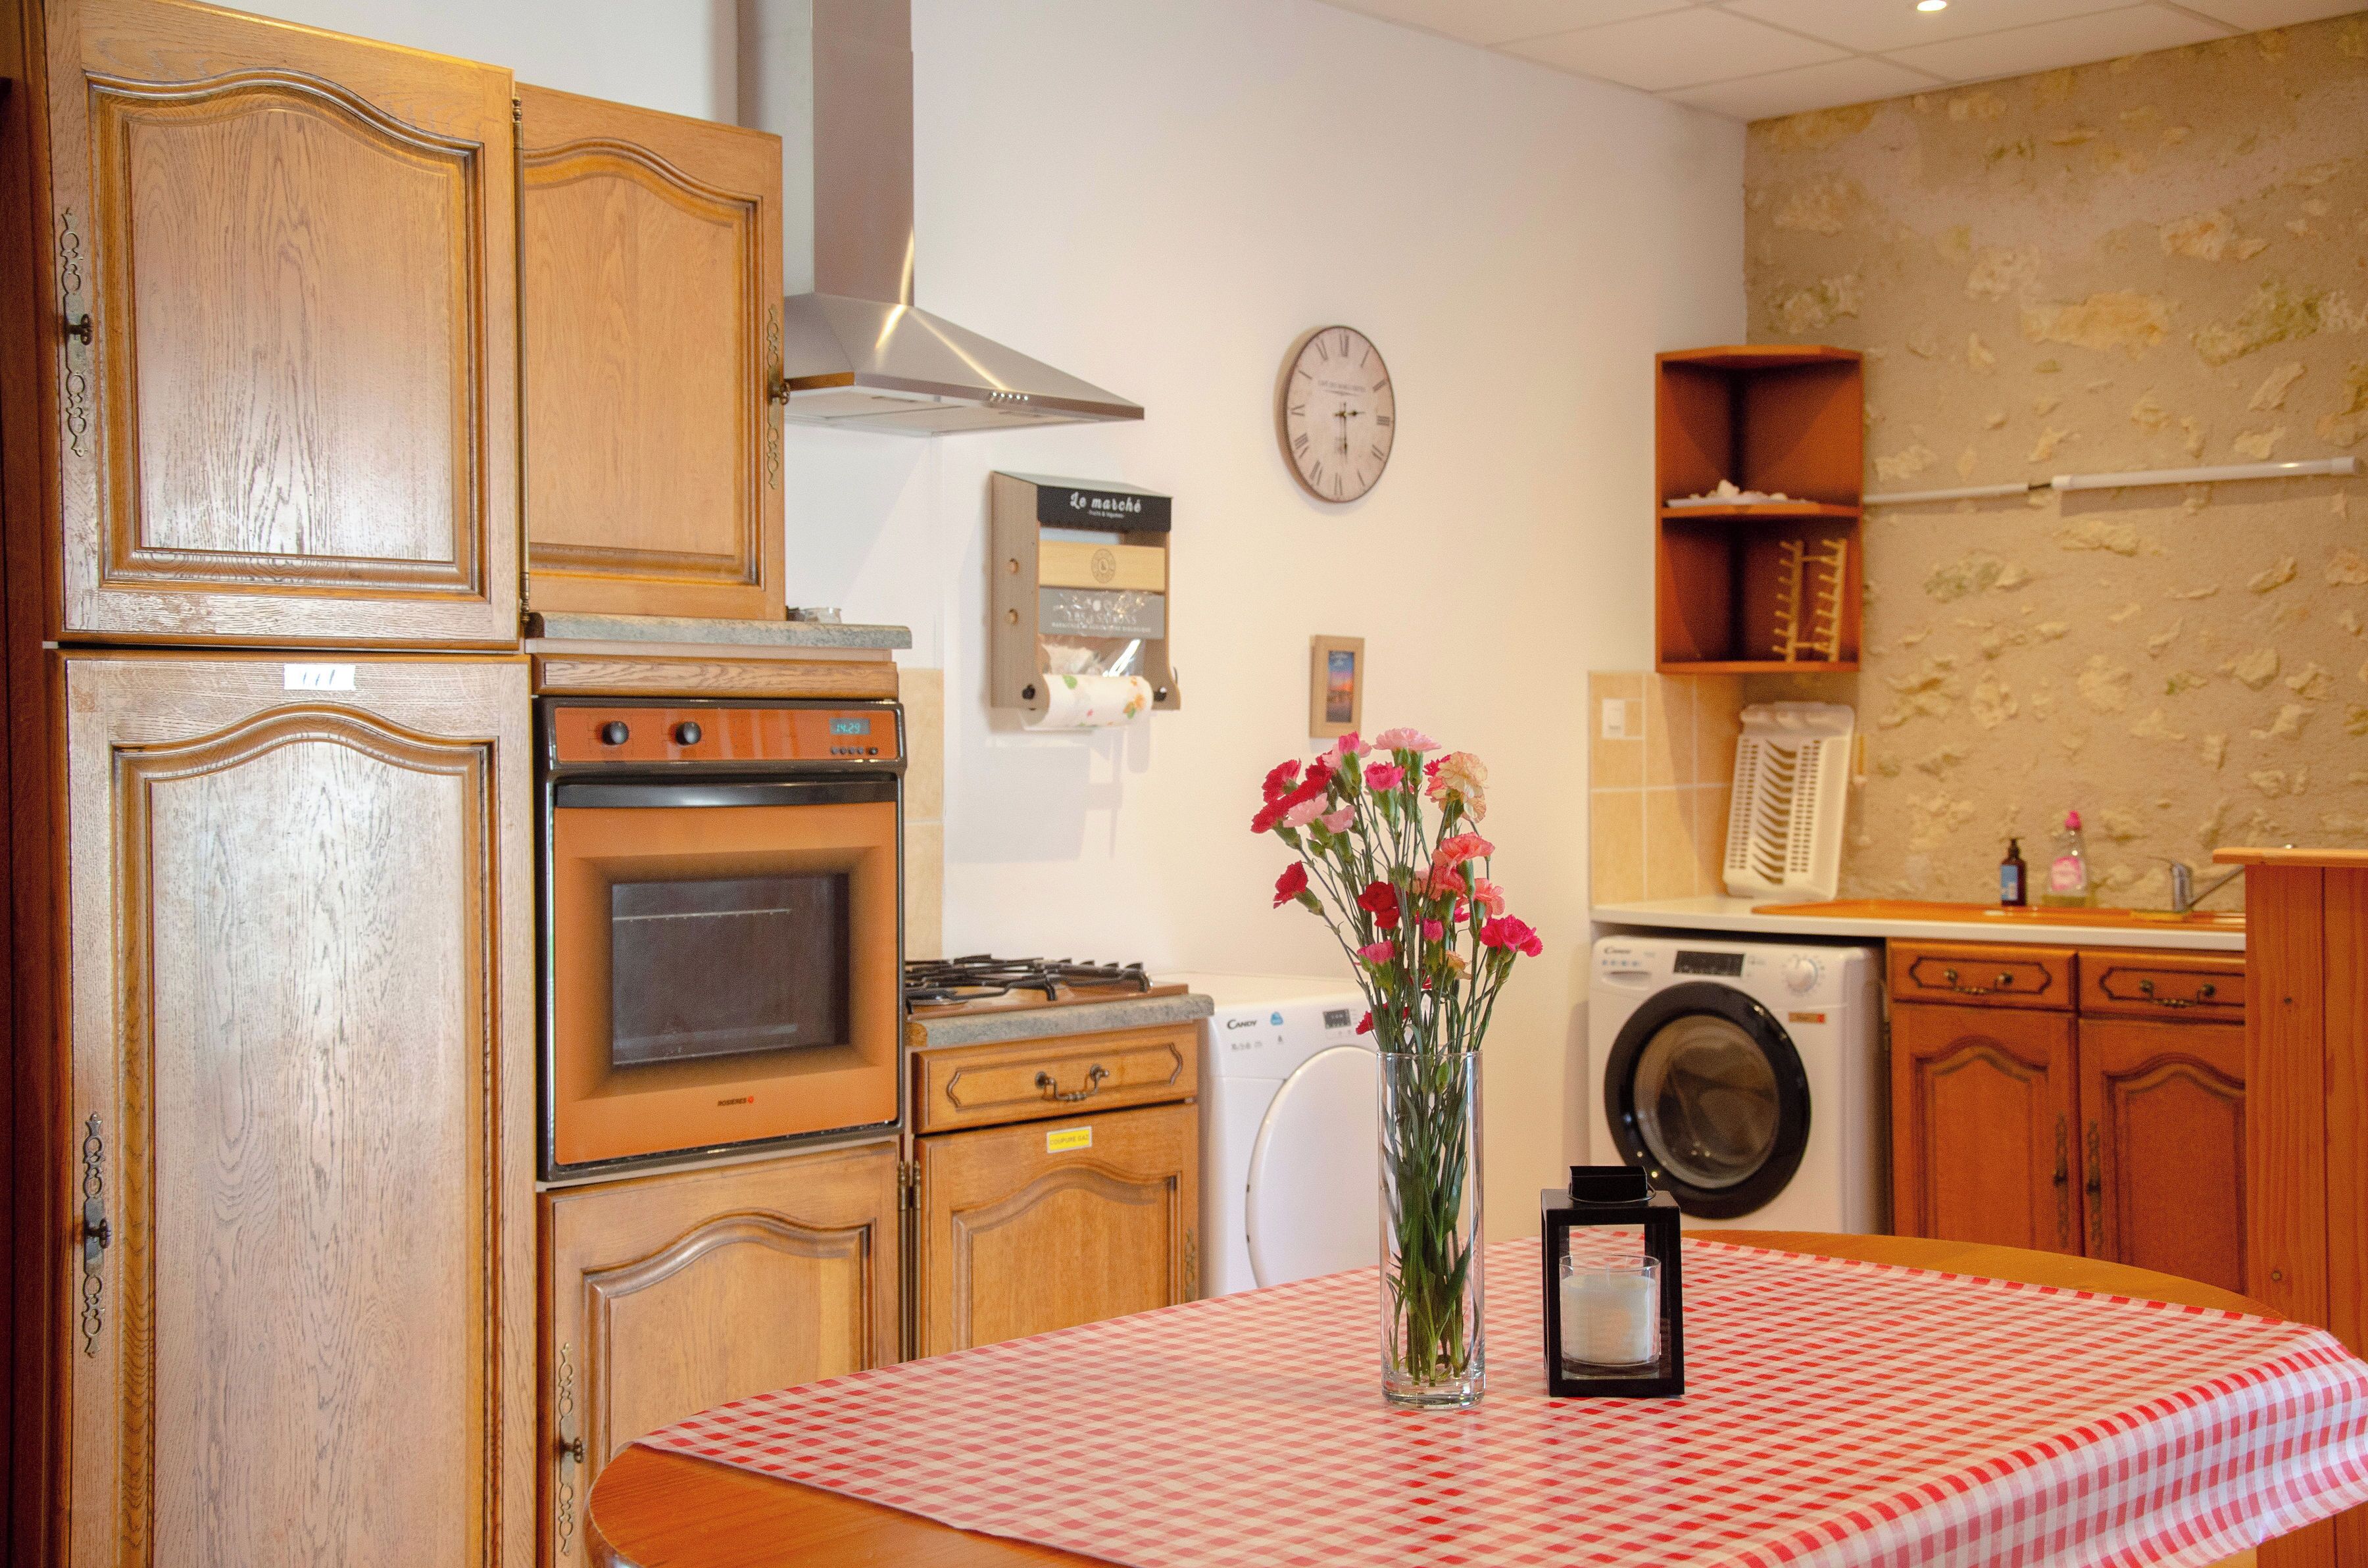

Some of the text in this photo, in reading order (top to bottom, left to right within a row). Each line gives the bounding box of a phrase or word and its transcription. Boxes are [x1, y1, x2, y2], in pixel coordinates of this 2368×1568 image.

[1070, 491, 1142, 513] Le marché
[1227, 1019, 1258, 1030] CANDY
